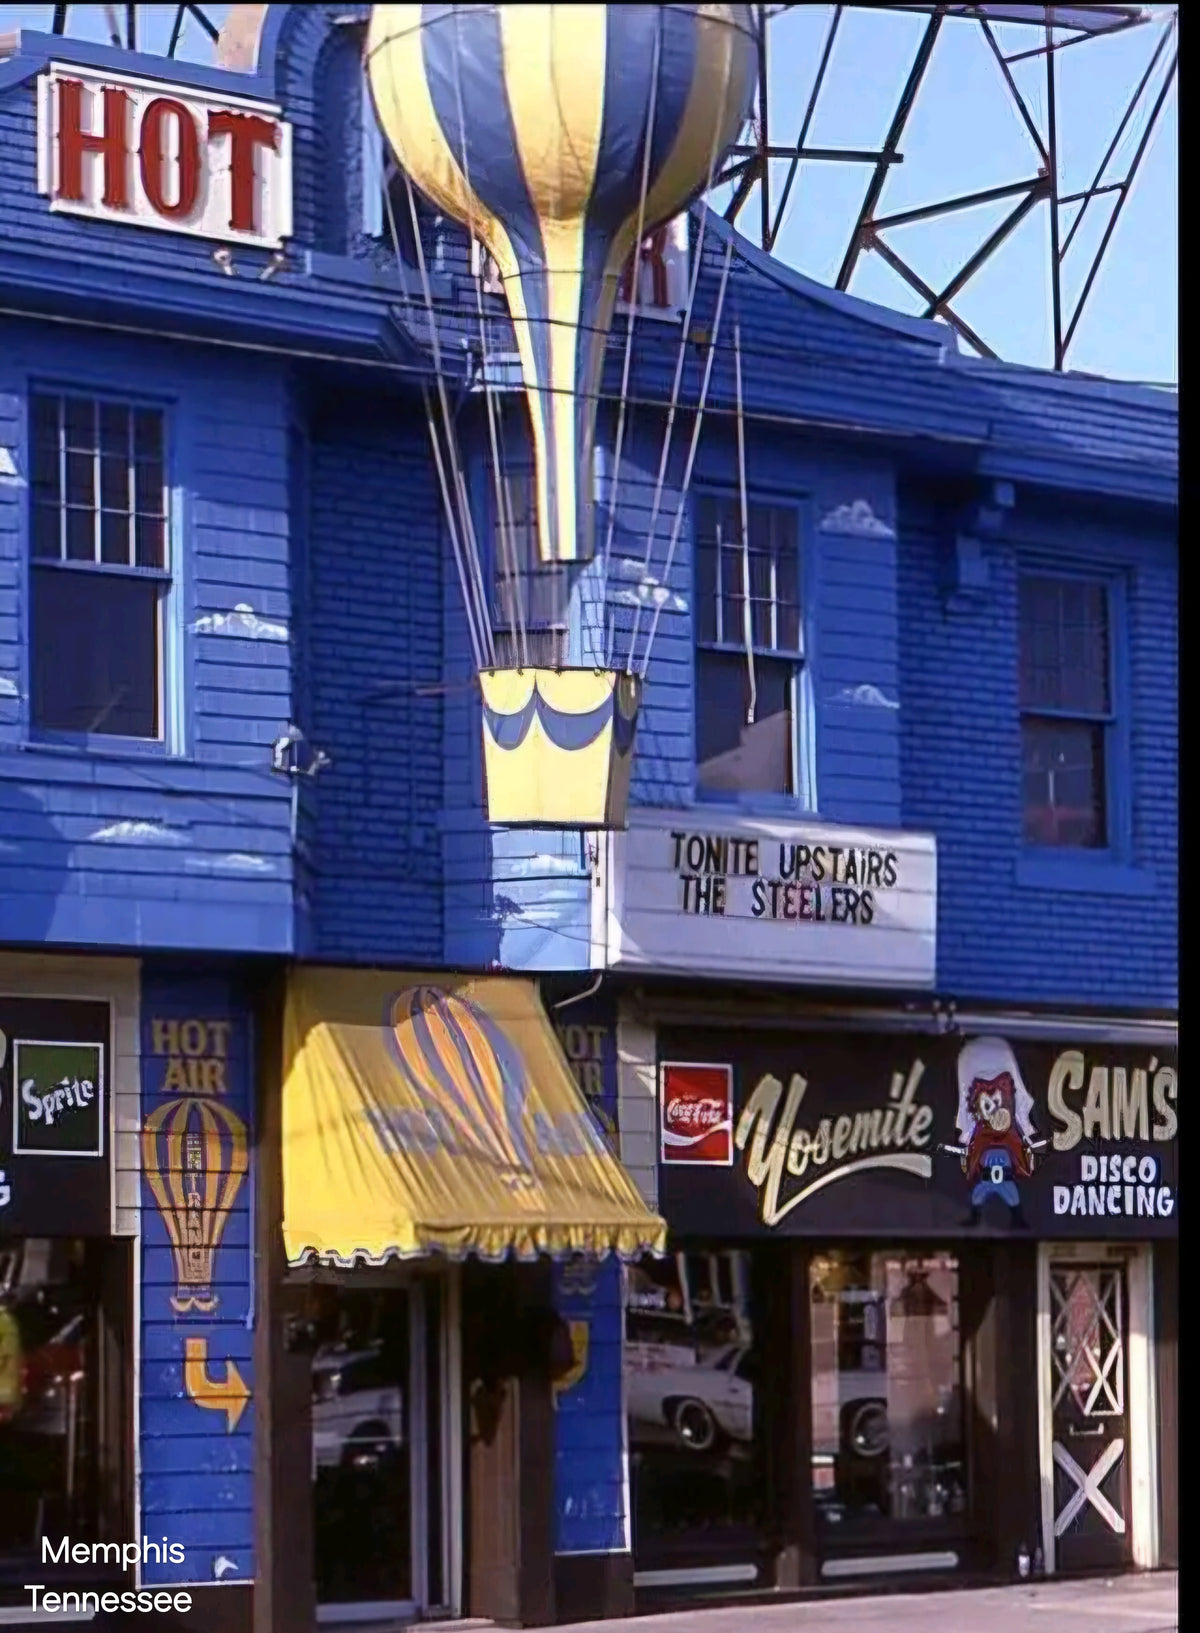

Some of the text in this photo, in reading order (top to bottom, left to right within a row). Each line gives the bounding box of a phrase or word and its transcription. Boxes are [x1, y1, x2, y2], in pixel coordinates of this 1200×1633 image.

[56, 77, 281, 231] HOT
[671, 832, 898, 887] TONITE UPSTAIRS
[680, 874, 874, 924] THE STEELERS
[152, 1019, 231, 1056] HOT
[553, 1023, 608, 1059] OT
[163, 1057, 227, 1094] AIR
[21, 1076, 95, 1126] Sprite
[735, 1058, 934, 1227] Yosemite
[1081, 1154, 1157, 1184] DISCO
[1053, 1185, 1174, 1217] DANCING
